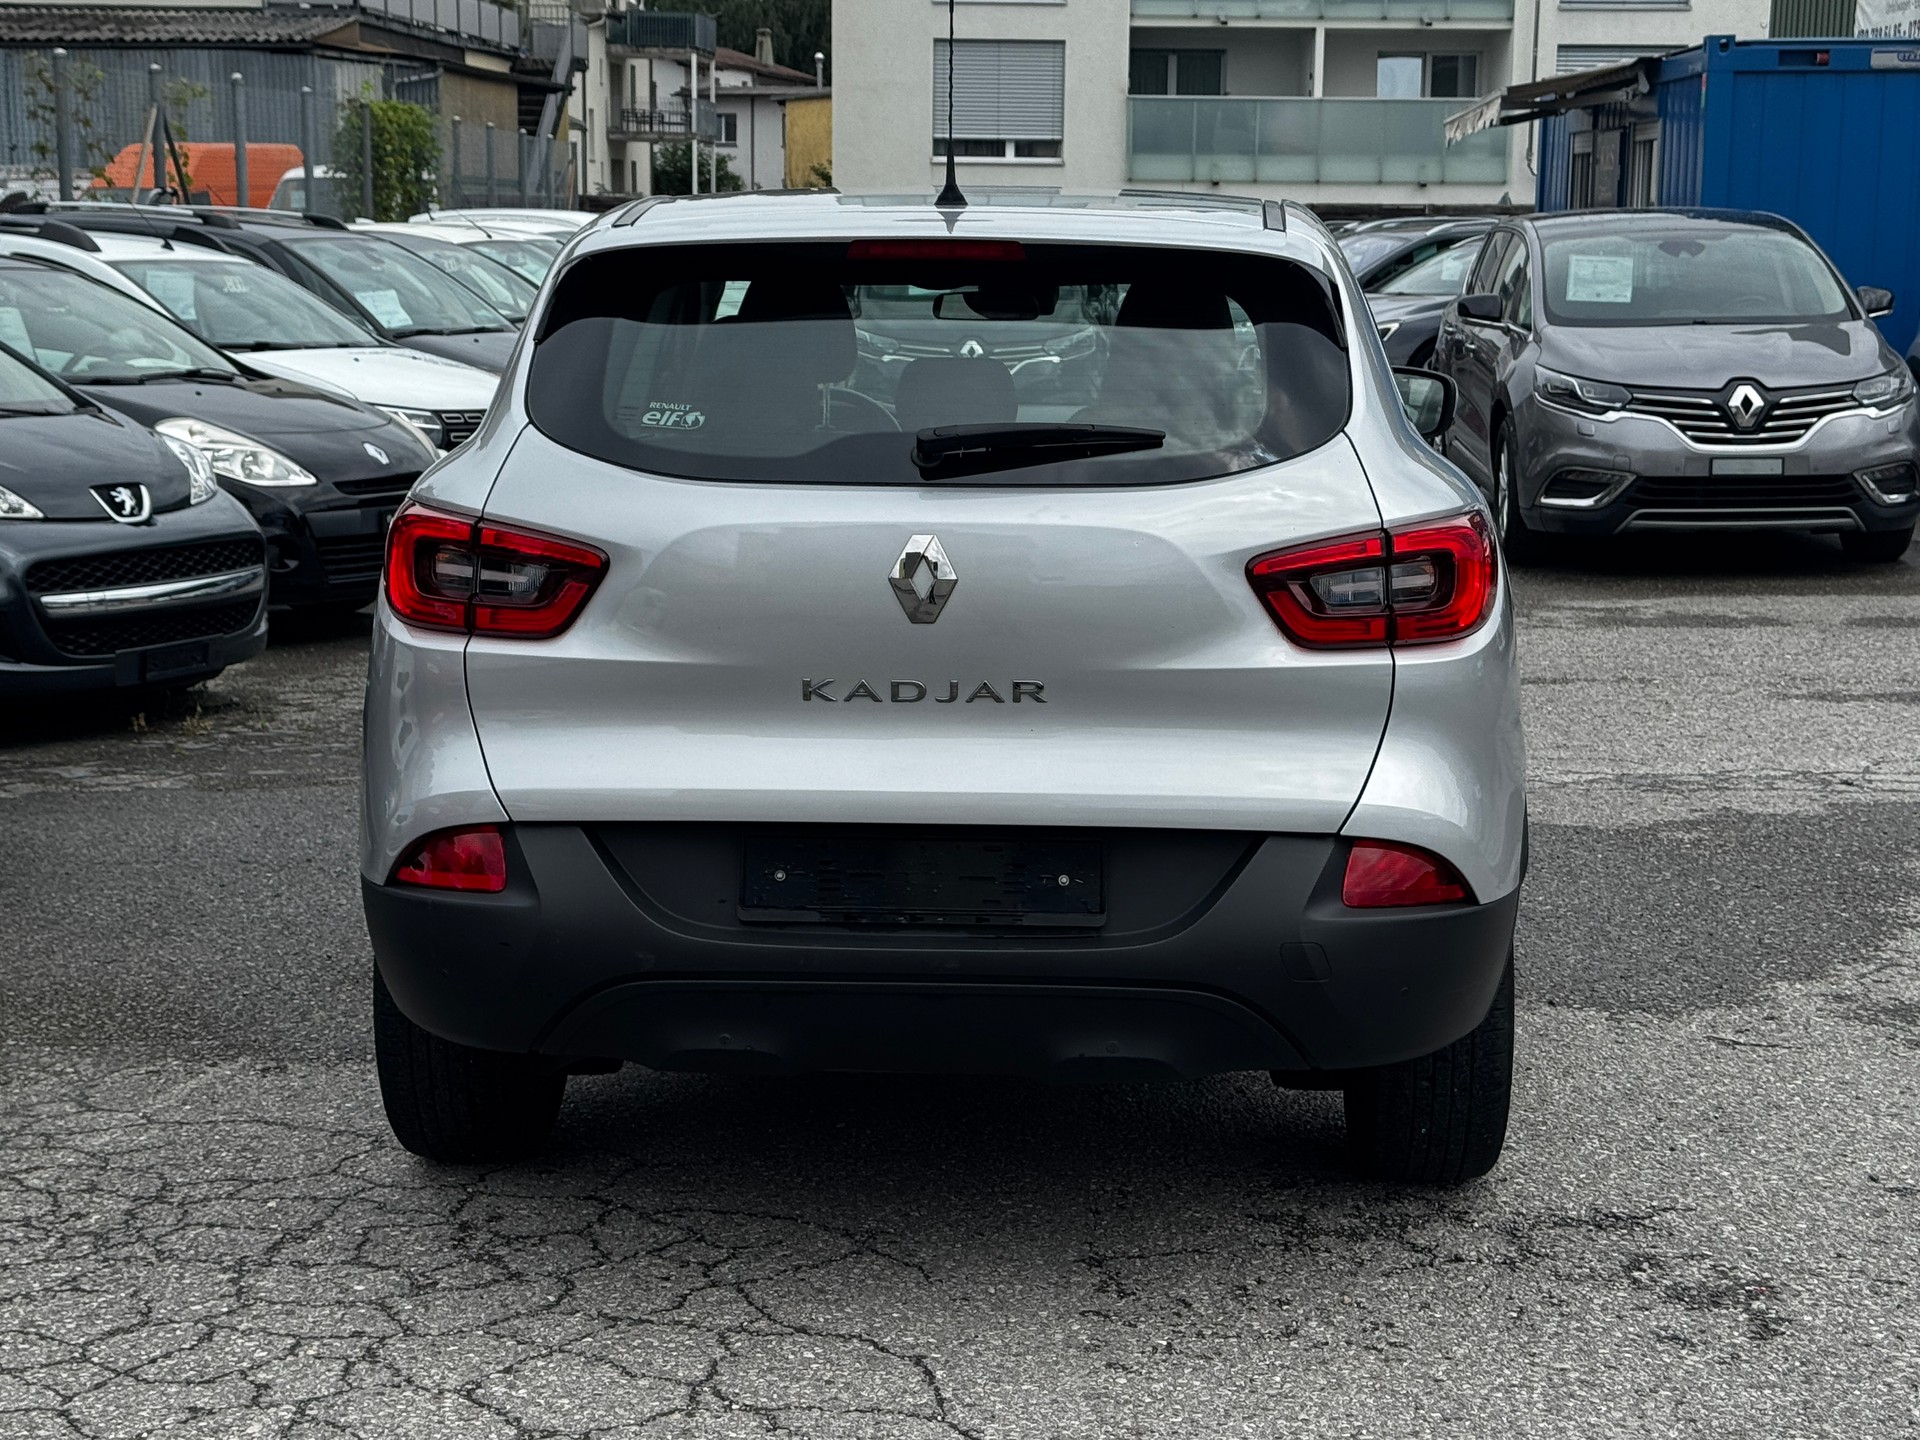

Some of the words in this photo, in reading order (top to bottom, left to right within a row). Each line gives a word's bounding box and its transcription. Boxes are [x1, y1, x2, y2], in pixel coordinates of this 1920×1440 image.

[649, 401, 692, 411] RENAULT
[642, 410, 684, 426] elf
[802, 678, 1048, 703] KADJAR
